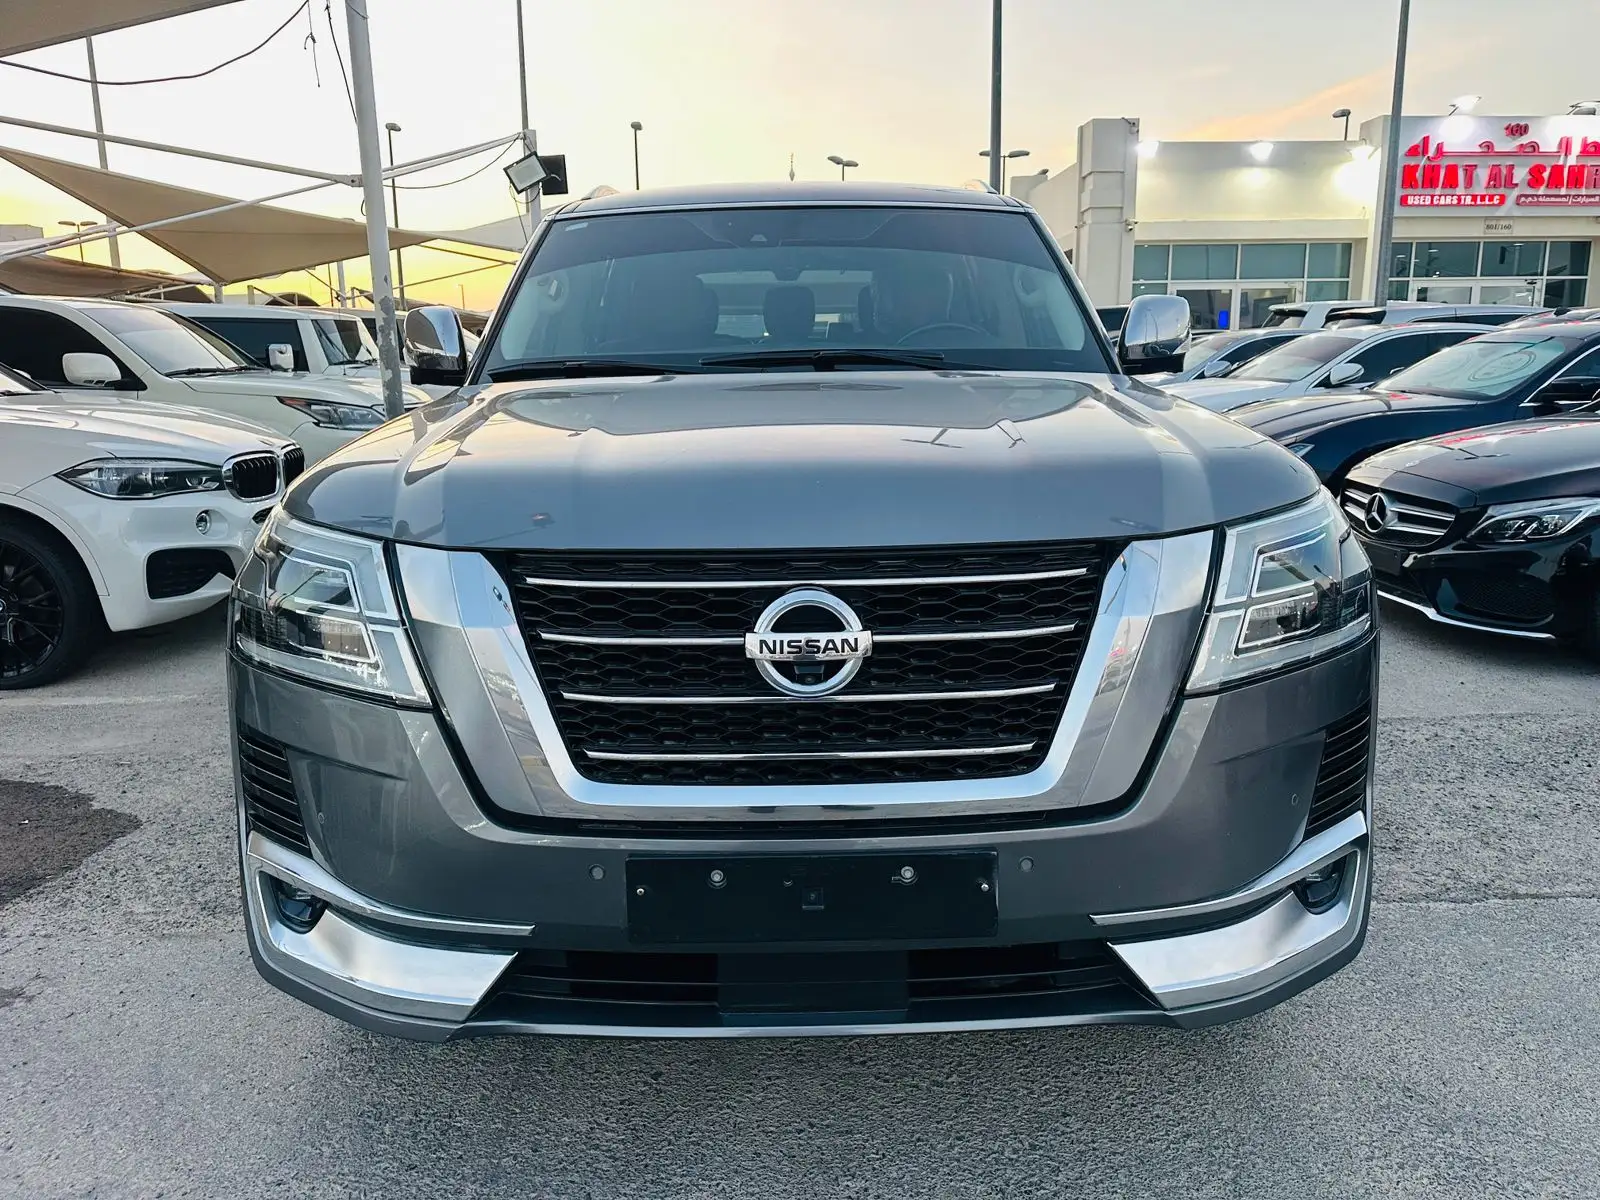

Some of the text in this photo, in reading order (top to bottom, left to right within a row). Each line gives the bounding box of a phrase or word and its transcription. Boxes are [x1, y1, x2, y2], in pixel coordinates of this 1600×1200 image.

[1504, 123, 1530, 137] 160
[1402, 163, 1478, 189] KHAT
[1484, 163, 1519, 189] AL
[1407, 195, 1500, 205] USED CARS TR. L.L.C
[759, 637, 859, 655] NISSAN
